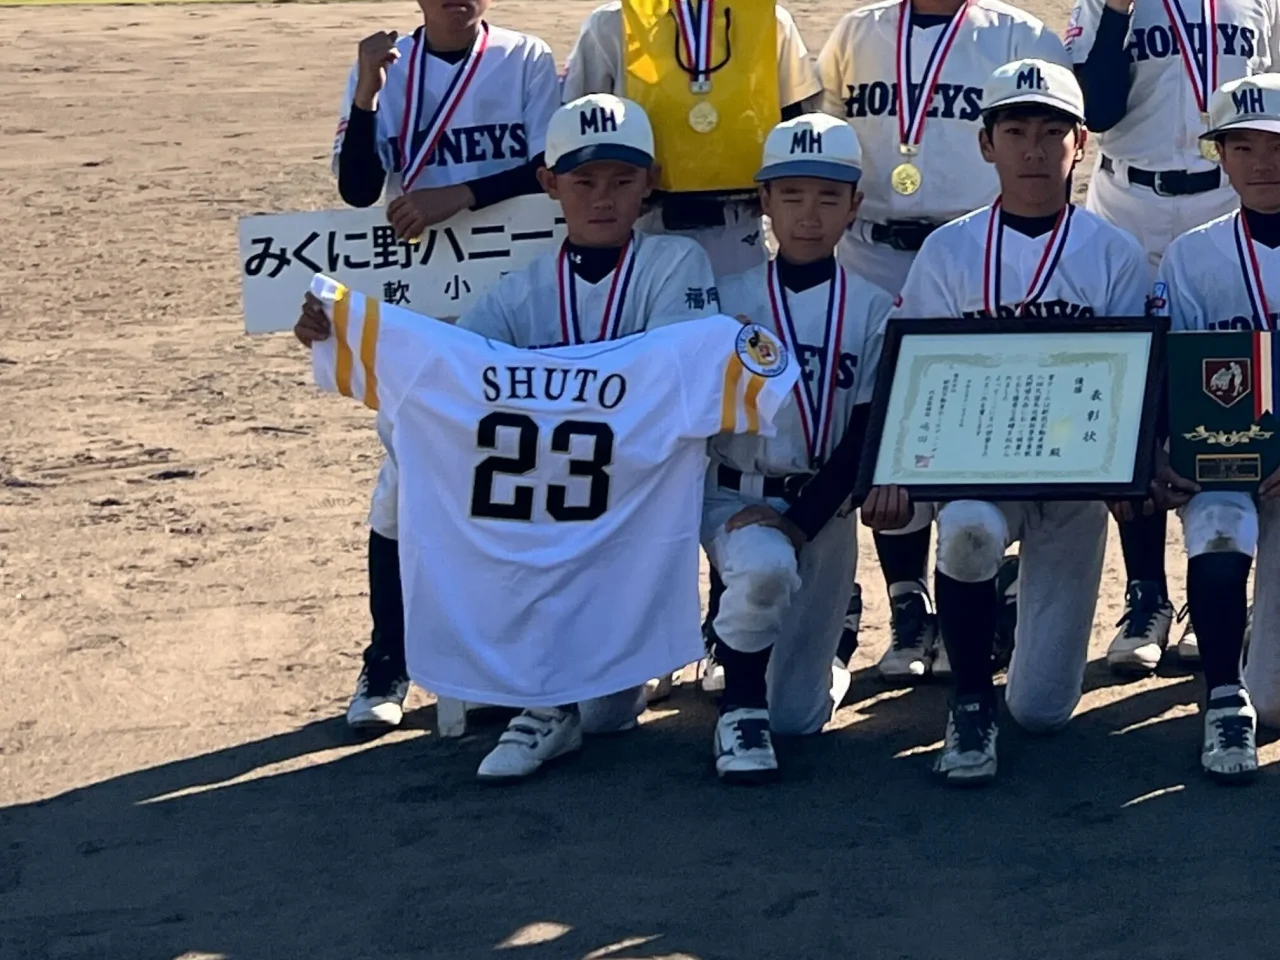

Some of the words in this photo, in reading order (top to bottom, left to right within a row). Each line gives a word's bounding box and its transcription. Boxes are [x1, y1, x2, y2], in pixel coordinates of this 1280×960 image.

[1231, 88, 1265, 115] MH
[580, 106, 617, 135] MH
[790, 128, 822, 154] MH
[245, 217, 567, 278] みくに野ハニー
[482, 366, 627, 409] SHUTO
[470, 411, 614, 522] 23
